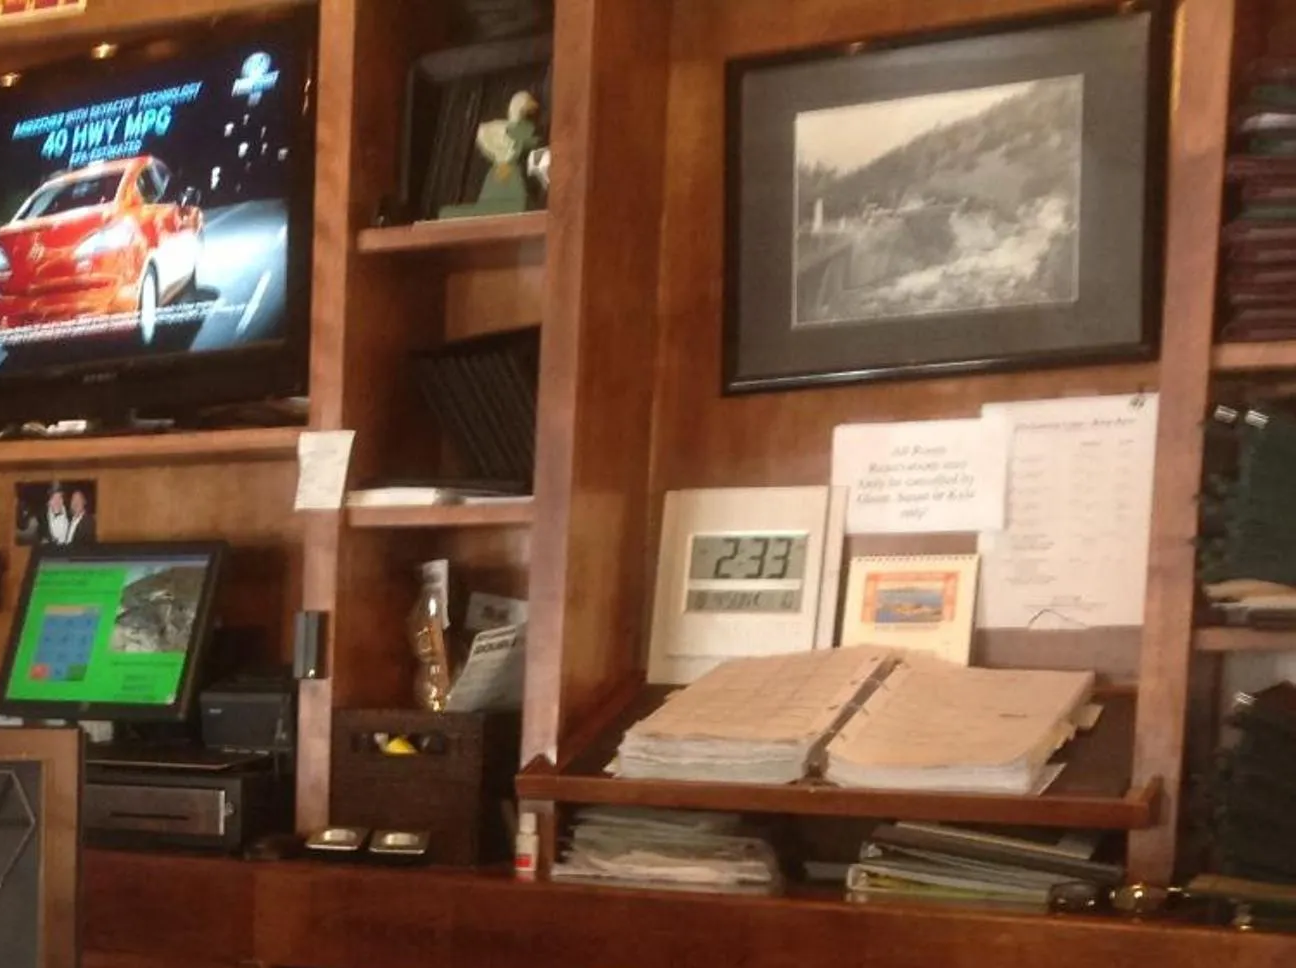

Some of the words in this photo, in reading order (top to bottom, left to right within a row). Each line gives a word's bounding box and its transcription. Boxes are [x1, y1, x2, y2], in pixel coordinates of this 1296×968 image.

[41, 128, 69, 159] 40
[72, 117, 120, 151] HWY
[124, 105, 172, 138] MPG
